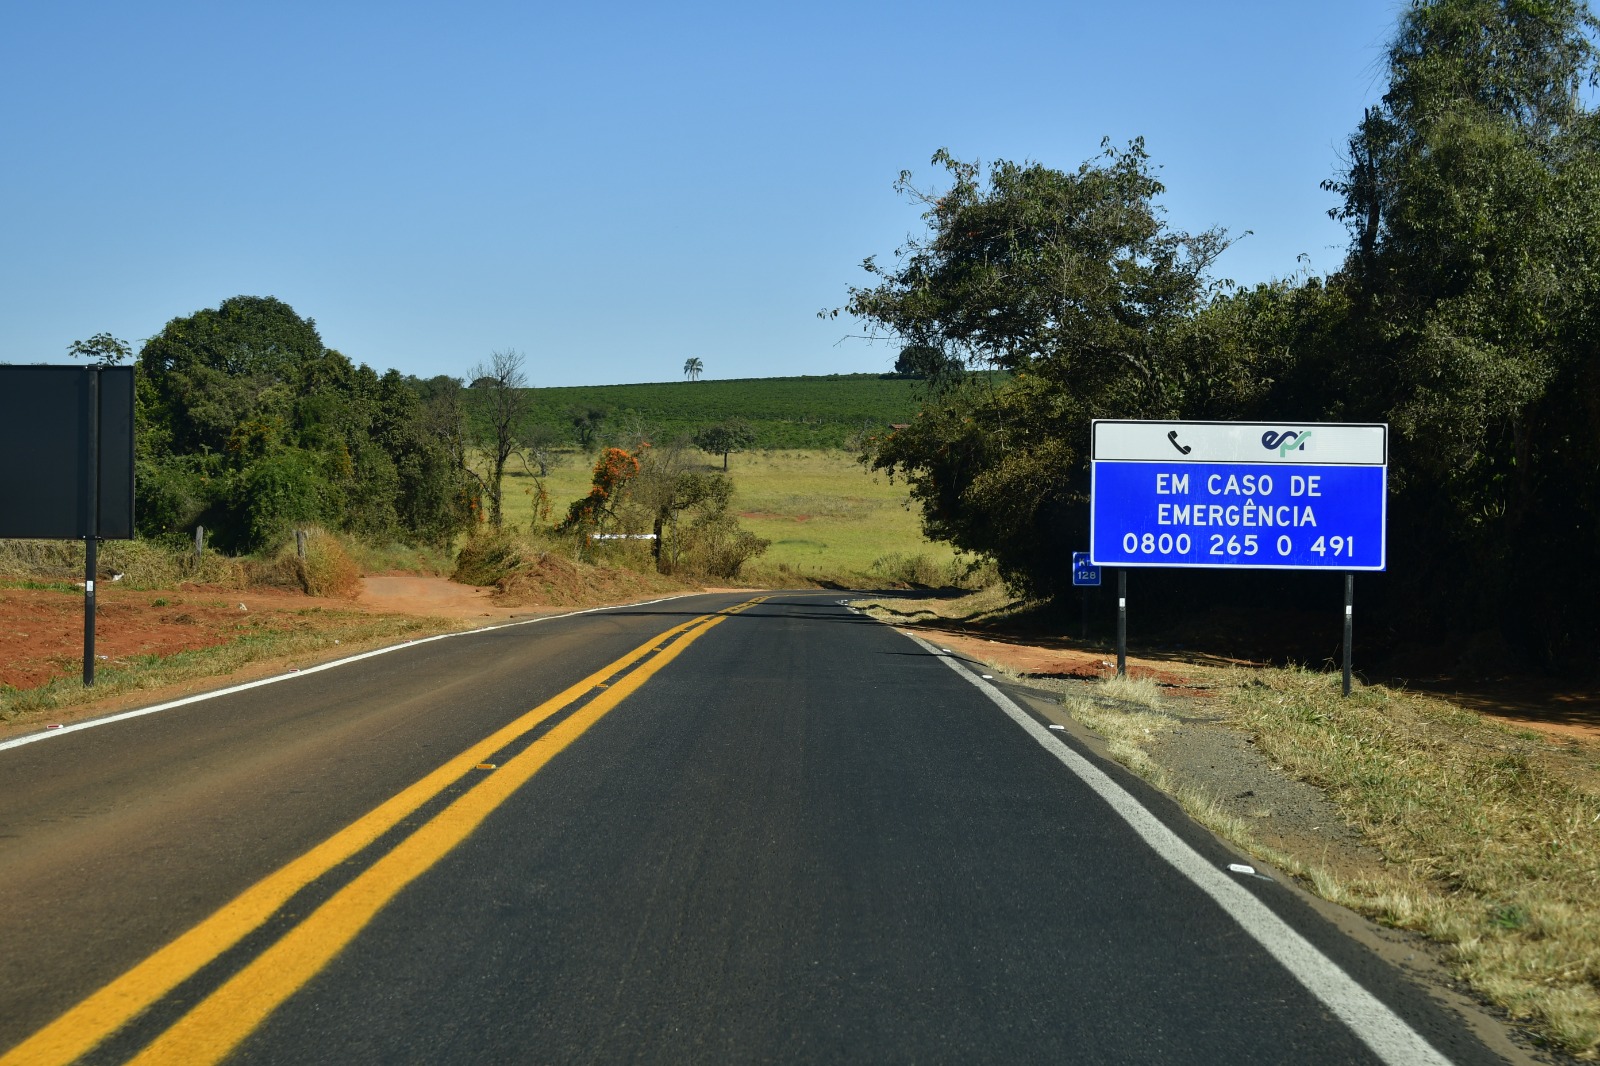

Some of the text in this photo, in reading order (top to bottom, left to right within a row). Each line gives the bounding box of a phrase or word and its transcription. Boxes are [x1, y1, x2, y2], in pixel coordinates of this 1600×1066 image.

[1156, 473, 1322, 497] EM CASO DE
[1157, 498, 1317, 527] EMERGÊNCIA
[1122, 532, 1353, 557] 0800 265 0 491
[1077, 571, 1097, 580] 128
